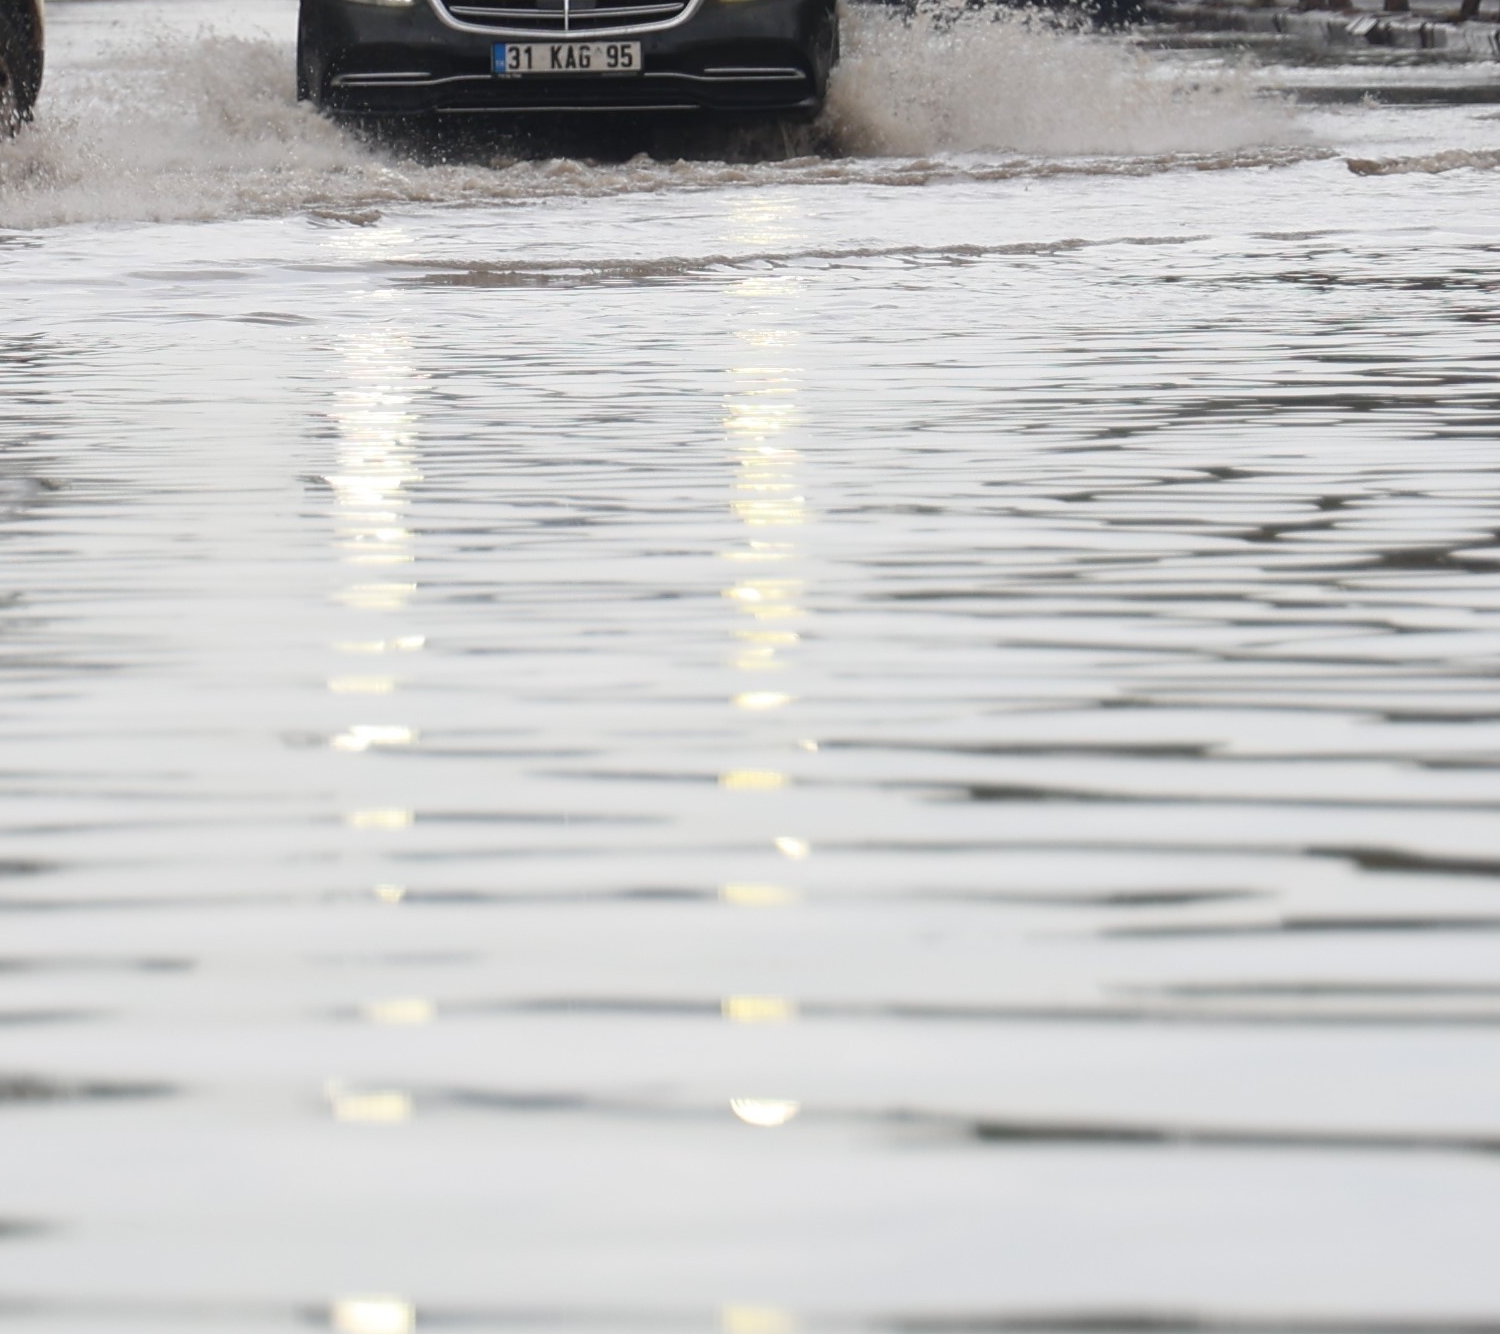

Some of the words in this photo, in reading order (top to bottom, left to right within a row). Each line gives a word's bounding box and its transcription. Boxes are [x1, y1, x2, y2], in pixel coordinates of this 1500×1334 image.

[508, 46, 533, 69] 31
[550, 45, 591, 69] KAG
[606, 44, 633, 68] 95
